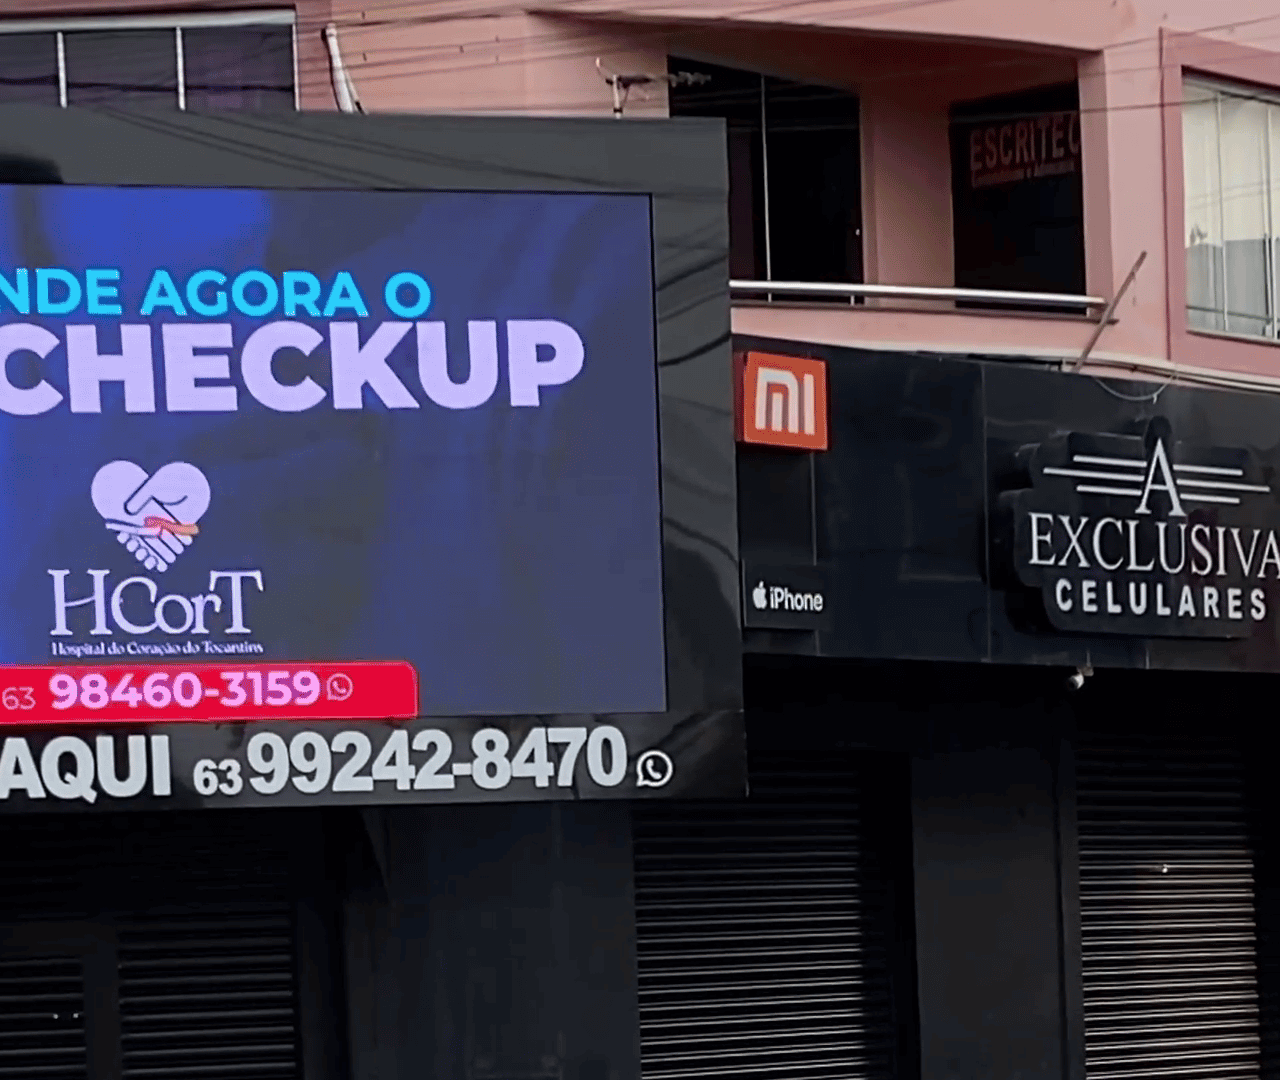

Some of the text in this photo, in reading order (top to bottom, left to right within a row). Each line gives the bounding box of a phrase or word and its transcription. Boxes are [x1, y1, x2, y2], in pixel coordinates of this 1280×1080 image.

[141, 270, 370, 318] AGORA
[384, 271, 431, 318] O
[1135, 437, 1187, 517] A
[48, 568, 265, 636] HCorT
[769, 586, 824, 612] iPhone
[1055, 577, 1267, 621] CELULARES
[51, 641, 106, 657] Hospital
[202, 640, 264, 655] Tocantins
[1, 670, 321, 711] 63 98460-3159
[193, 758, 243, 796] 63
[246, 725, 628, 795] 99242-8470
